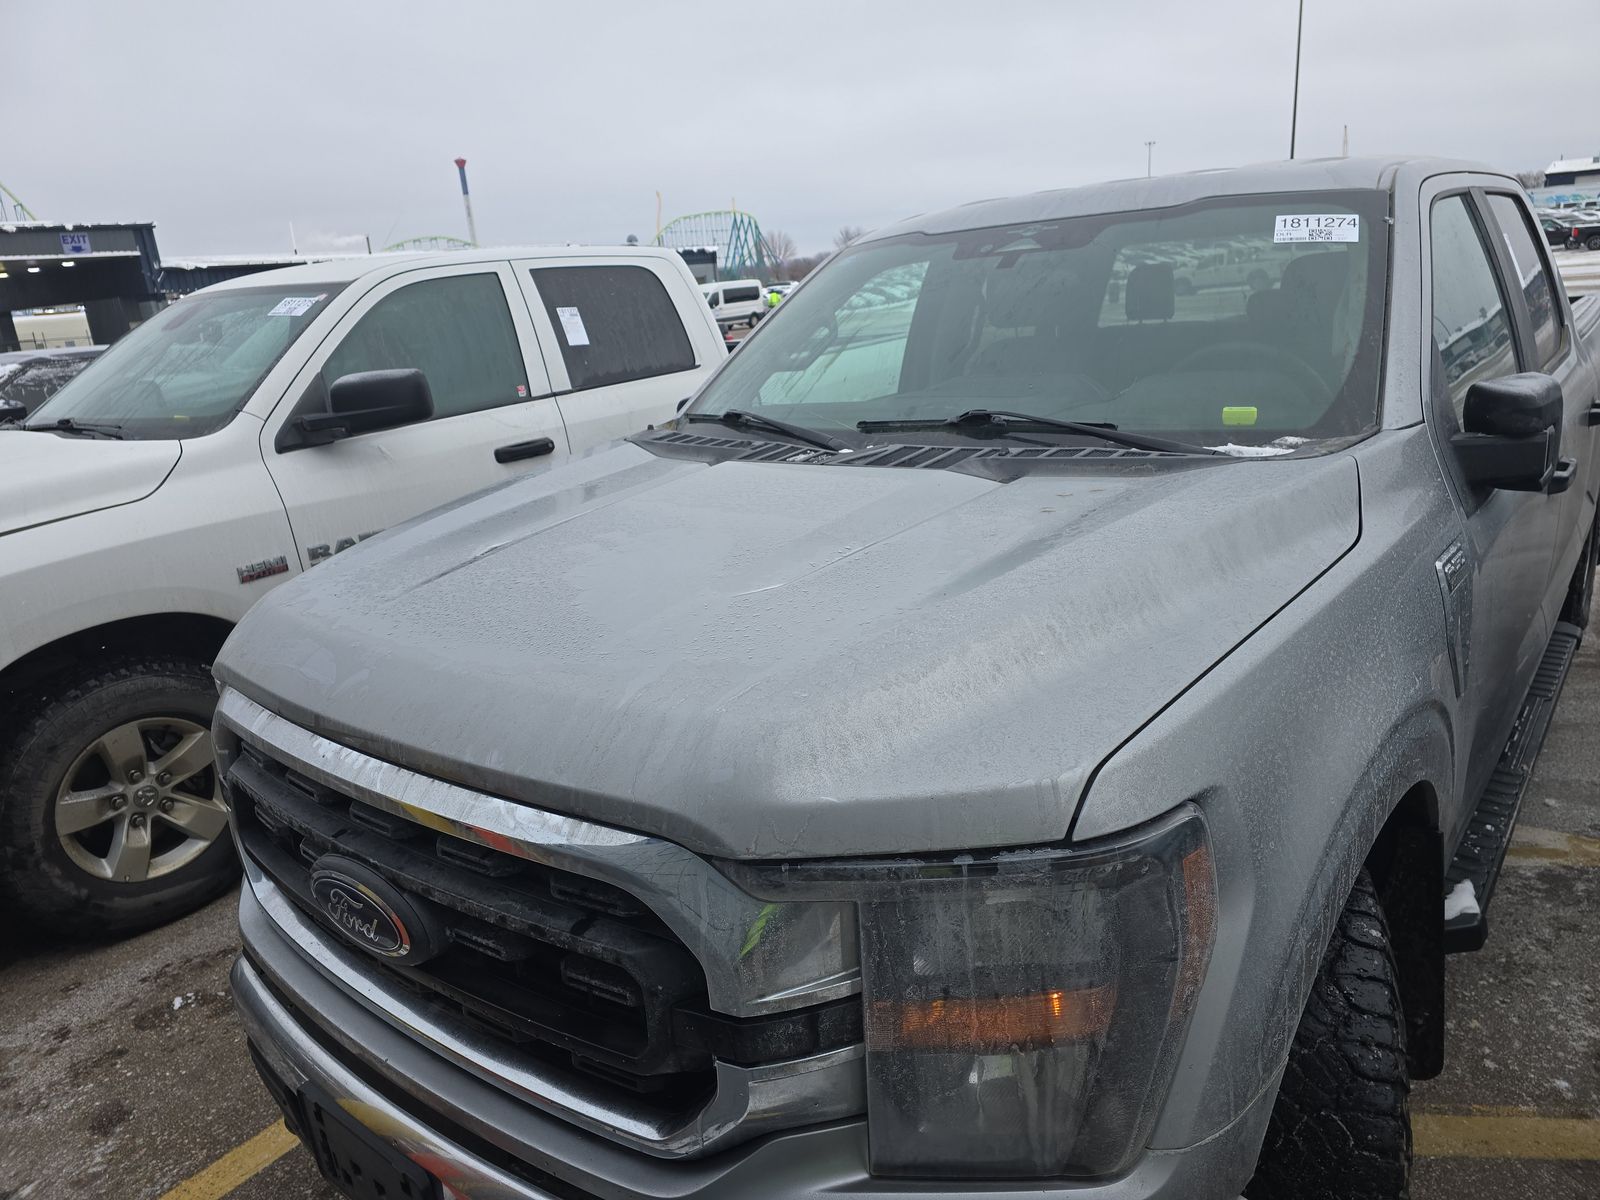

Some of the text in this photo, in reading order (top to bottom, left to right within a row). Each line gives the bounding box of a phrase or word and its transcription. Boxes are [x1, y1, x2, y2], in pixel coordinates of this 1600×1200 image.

[1280, 217, 1358, 229] 1811274
[61, 234, 87, 245] EXIT
[327, 888, 380, 942] Ford
